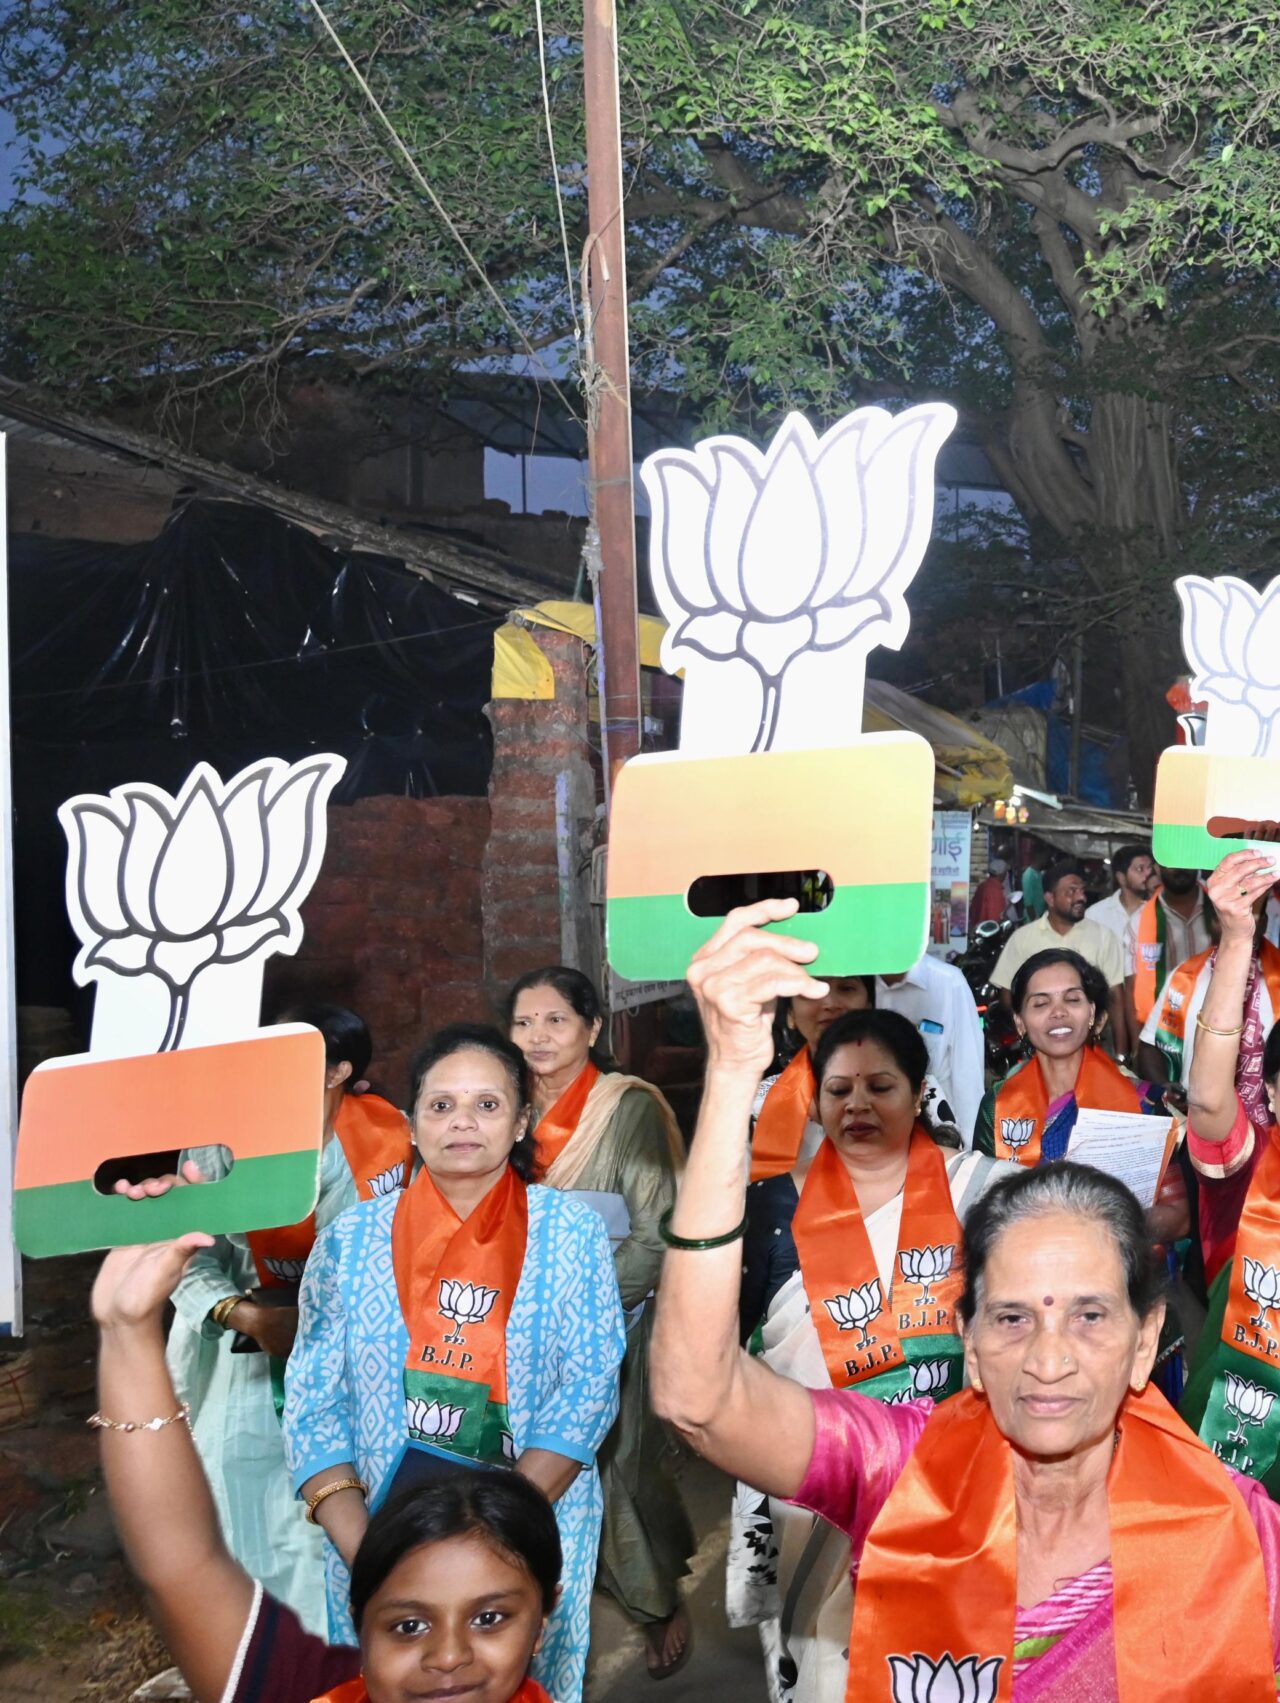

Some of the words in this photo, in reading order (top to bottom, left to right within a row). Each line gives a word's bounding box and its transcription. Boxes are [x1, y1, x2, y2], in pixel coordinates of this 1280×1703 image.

[899, 1310, 950, 1329] B.J.P.
[1233, 1324, 1280, 1358] B.J.P.
[421, 1345, 474, 1371] B.J.P.
[844, 1344, 897, 1377] B.J.P.
